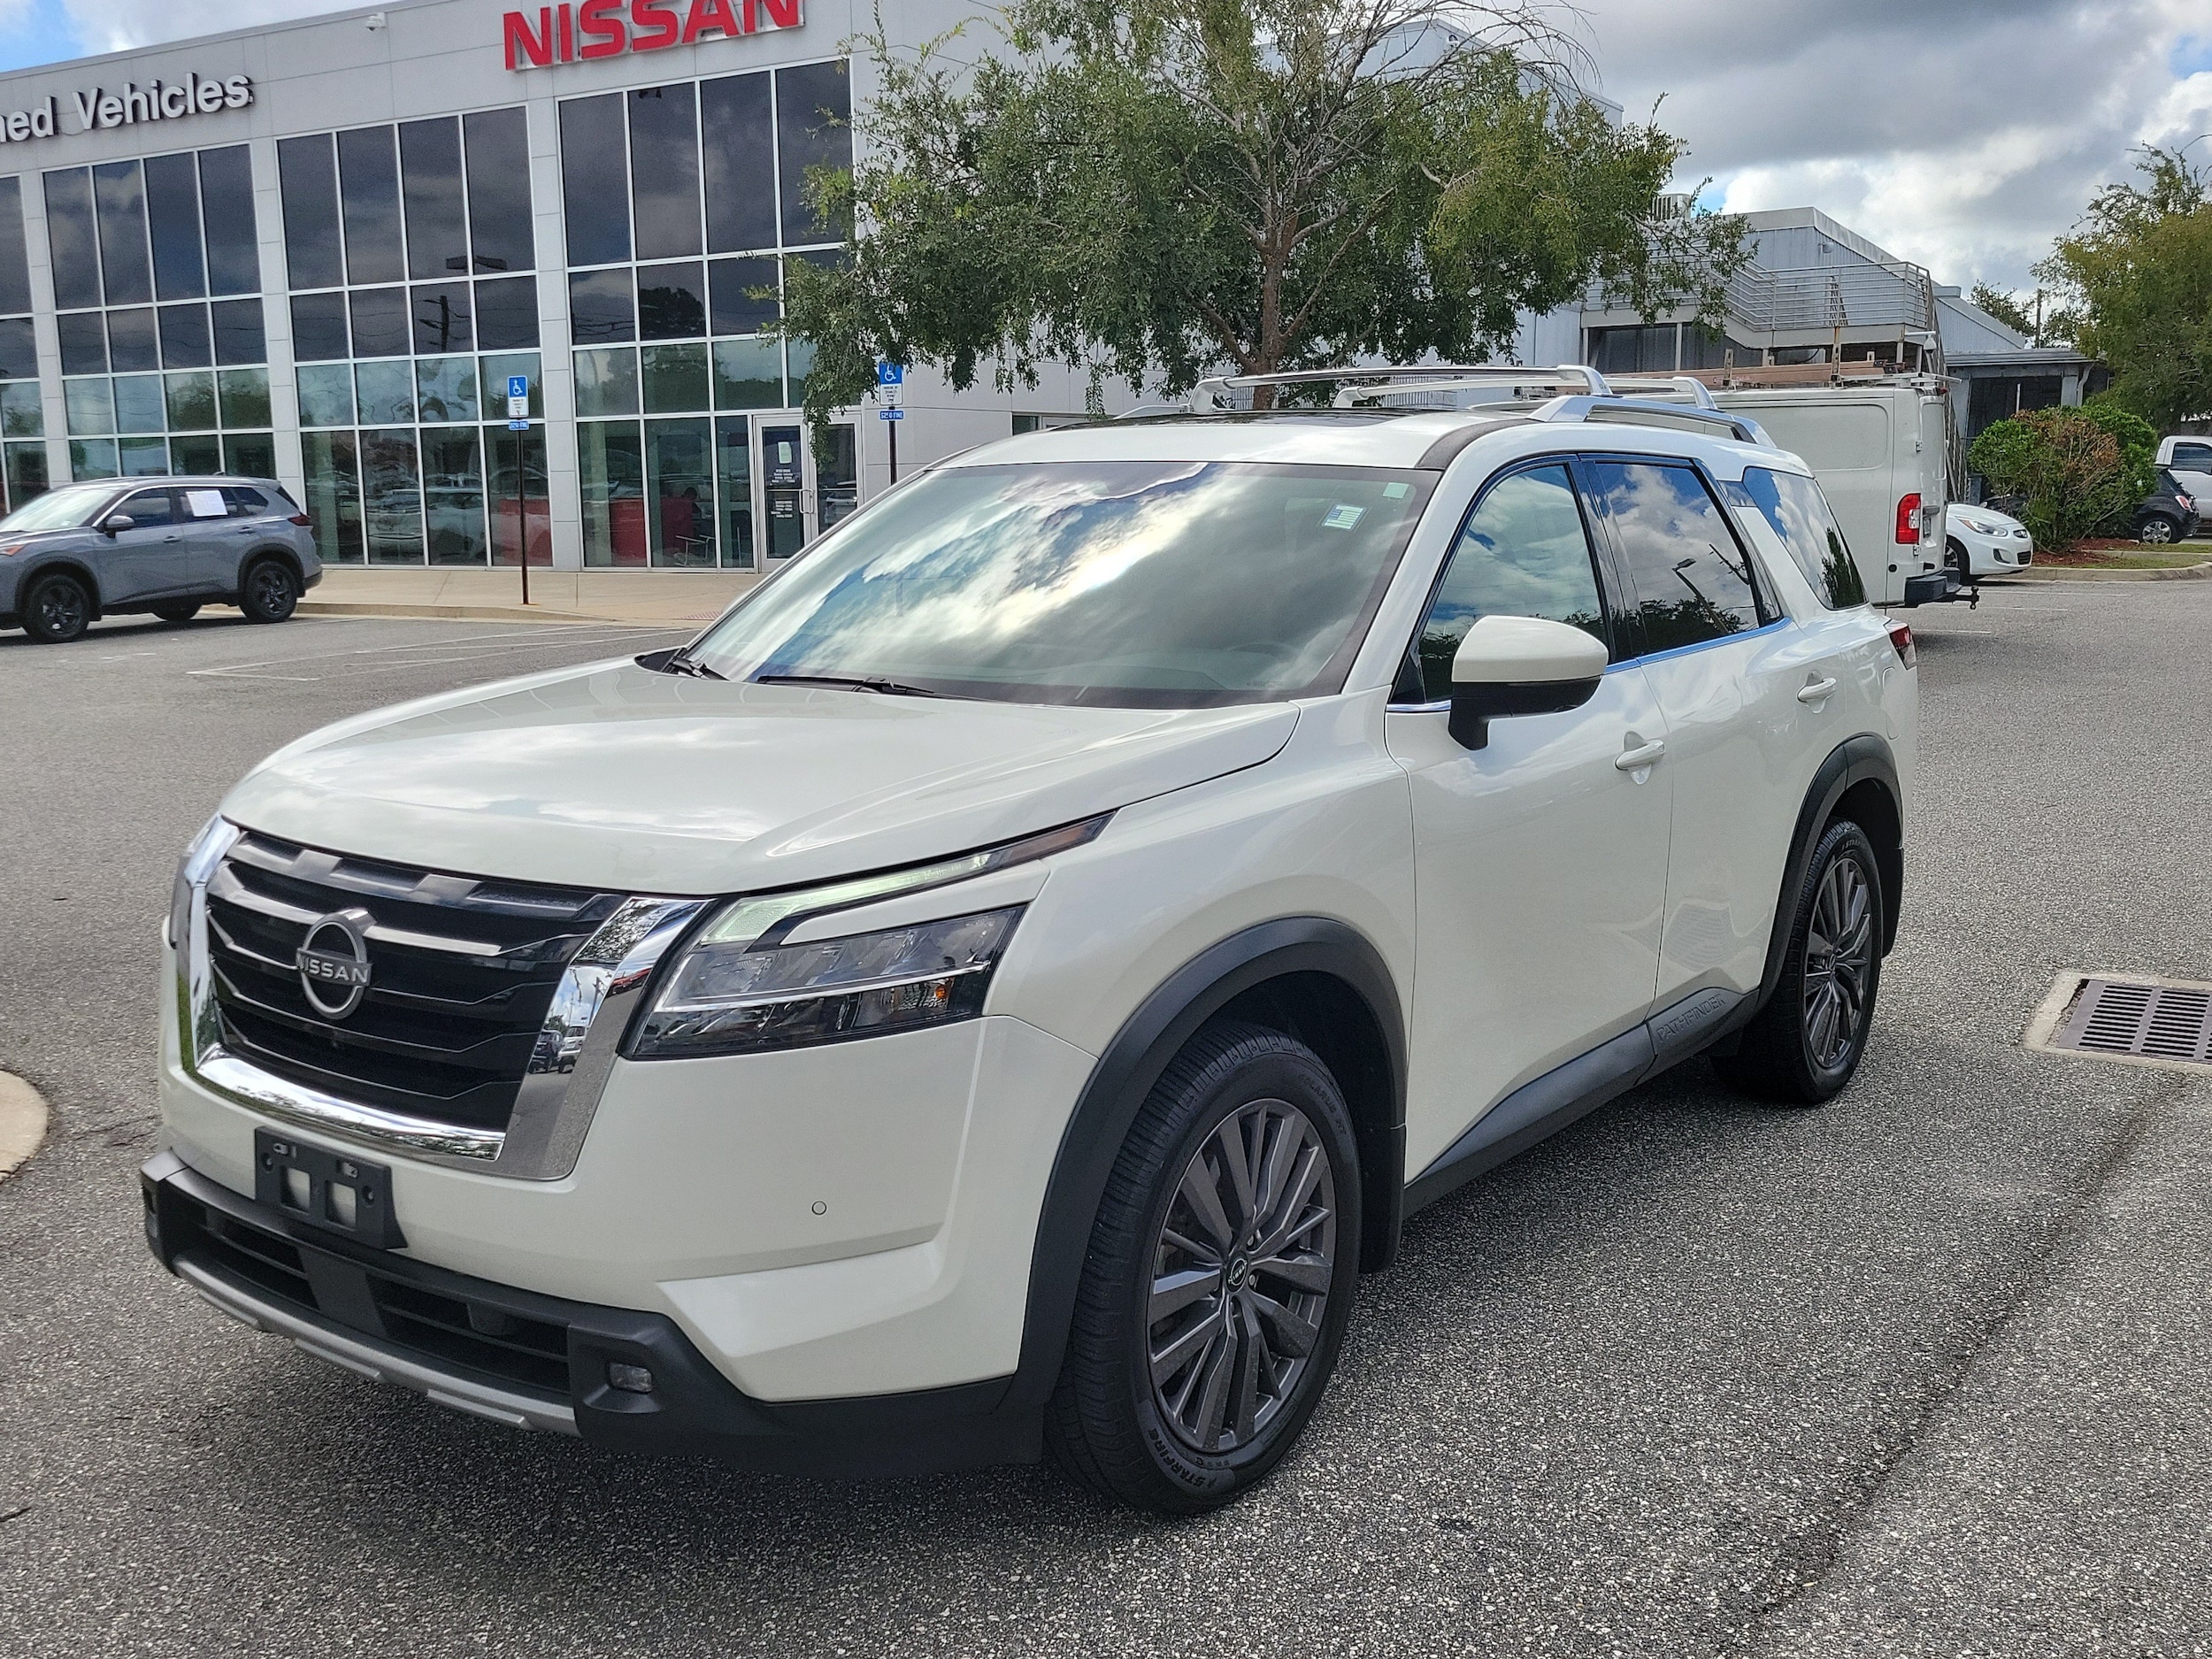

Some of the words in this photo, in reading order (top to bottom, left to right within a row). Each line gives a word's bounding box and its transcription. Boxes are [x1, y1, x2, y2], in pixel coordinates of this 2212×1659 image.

[0, 96, 54, 143] ed
[73, 72, 251, 130] Vehicles
[296, 953, 370, 984] NISSAN
[1656, 994, 1726, 1042] PATHFINDER
[1148, 1427, 1207, 1488] STARFIRE
